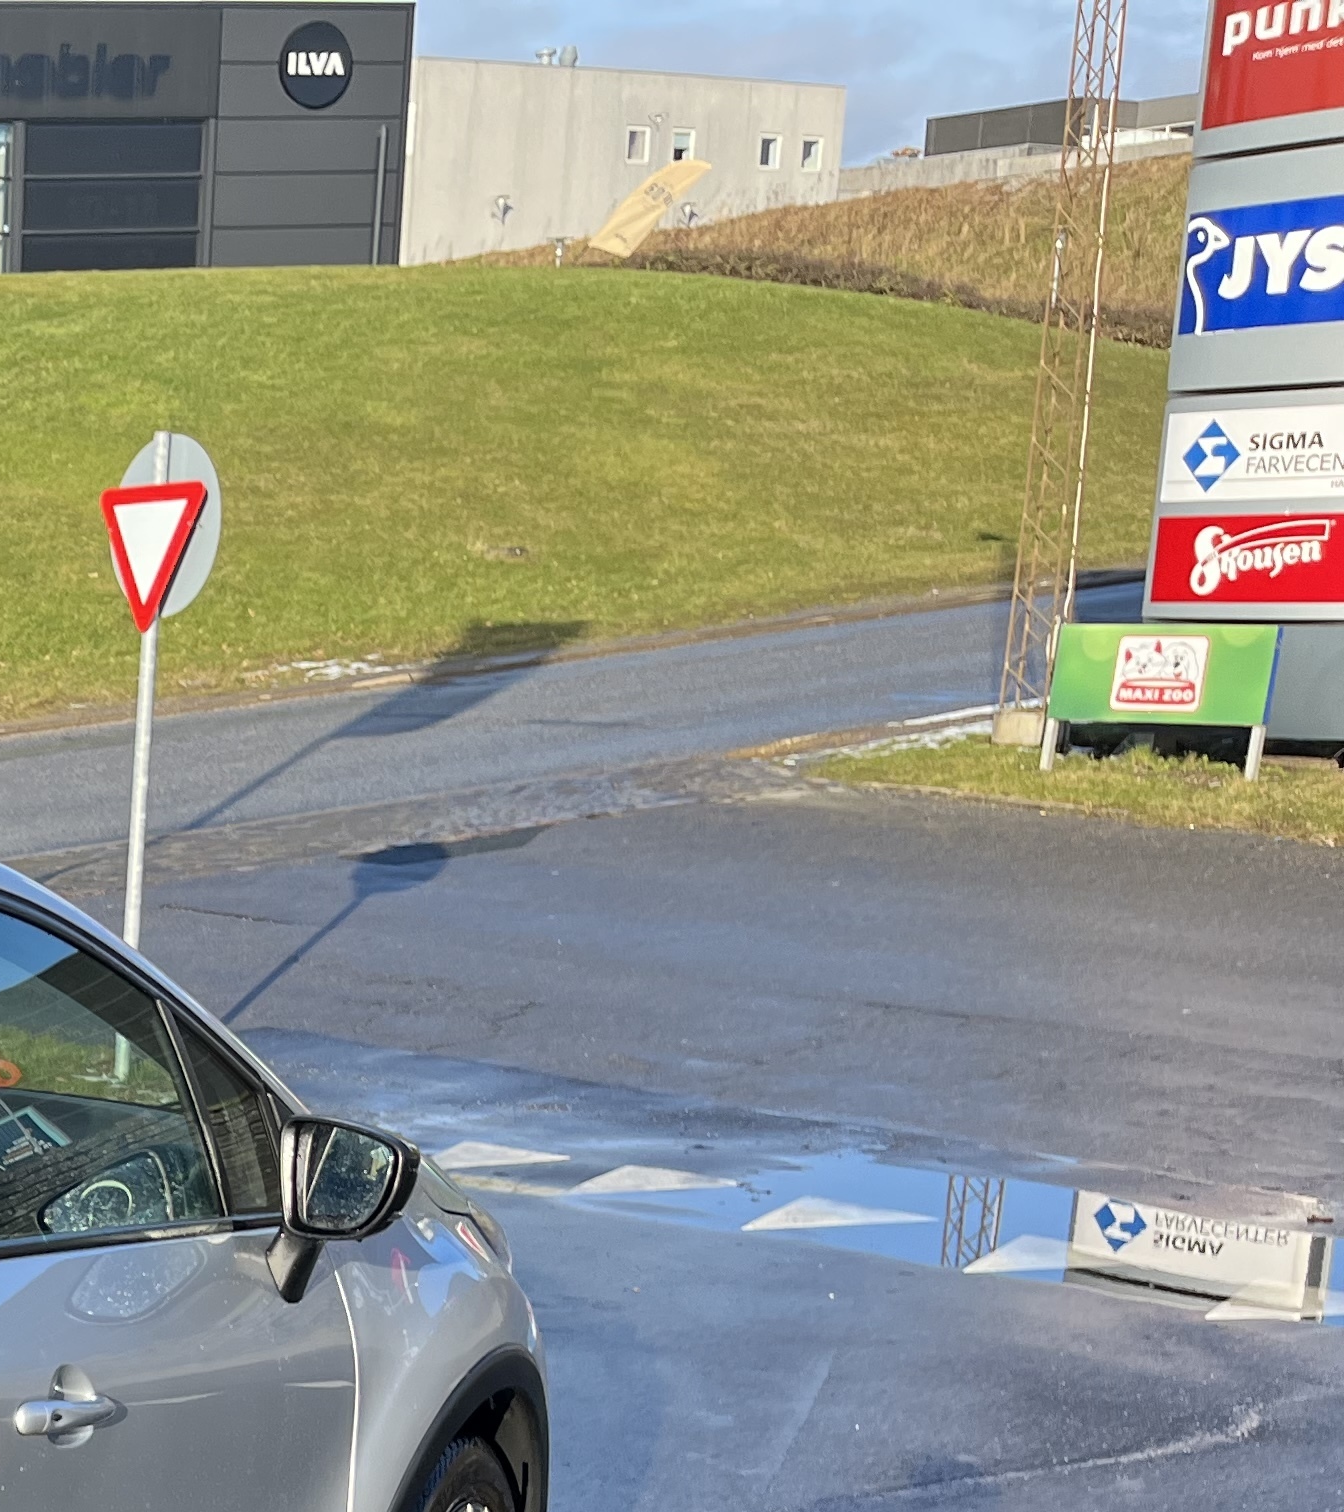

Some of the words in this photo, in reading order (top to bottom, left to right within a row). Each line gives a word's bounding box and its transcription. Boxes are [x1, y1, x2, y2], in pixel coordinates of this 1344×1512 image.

[287, 51, 346, 76] ILVA
[1249, 431, 1324, 452] SIGMA
[1190, 525, 1322, 596] Skousen
[1119, 687, 1160, 701] MAXI
[1162, 689, 1194, 702] ZOO
